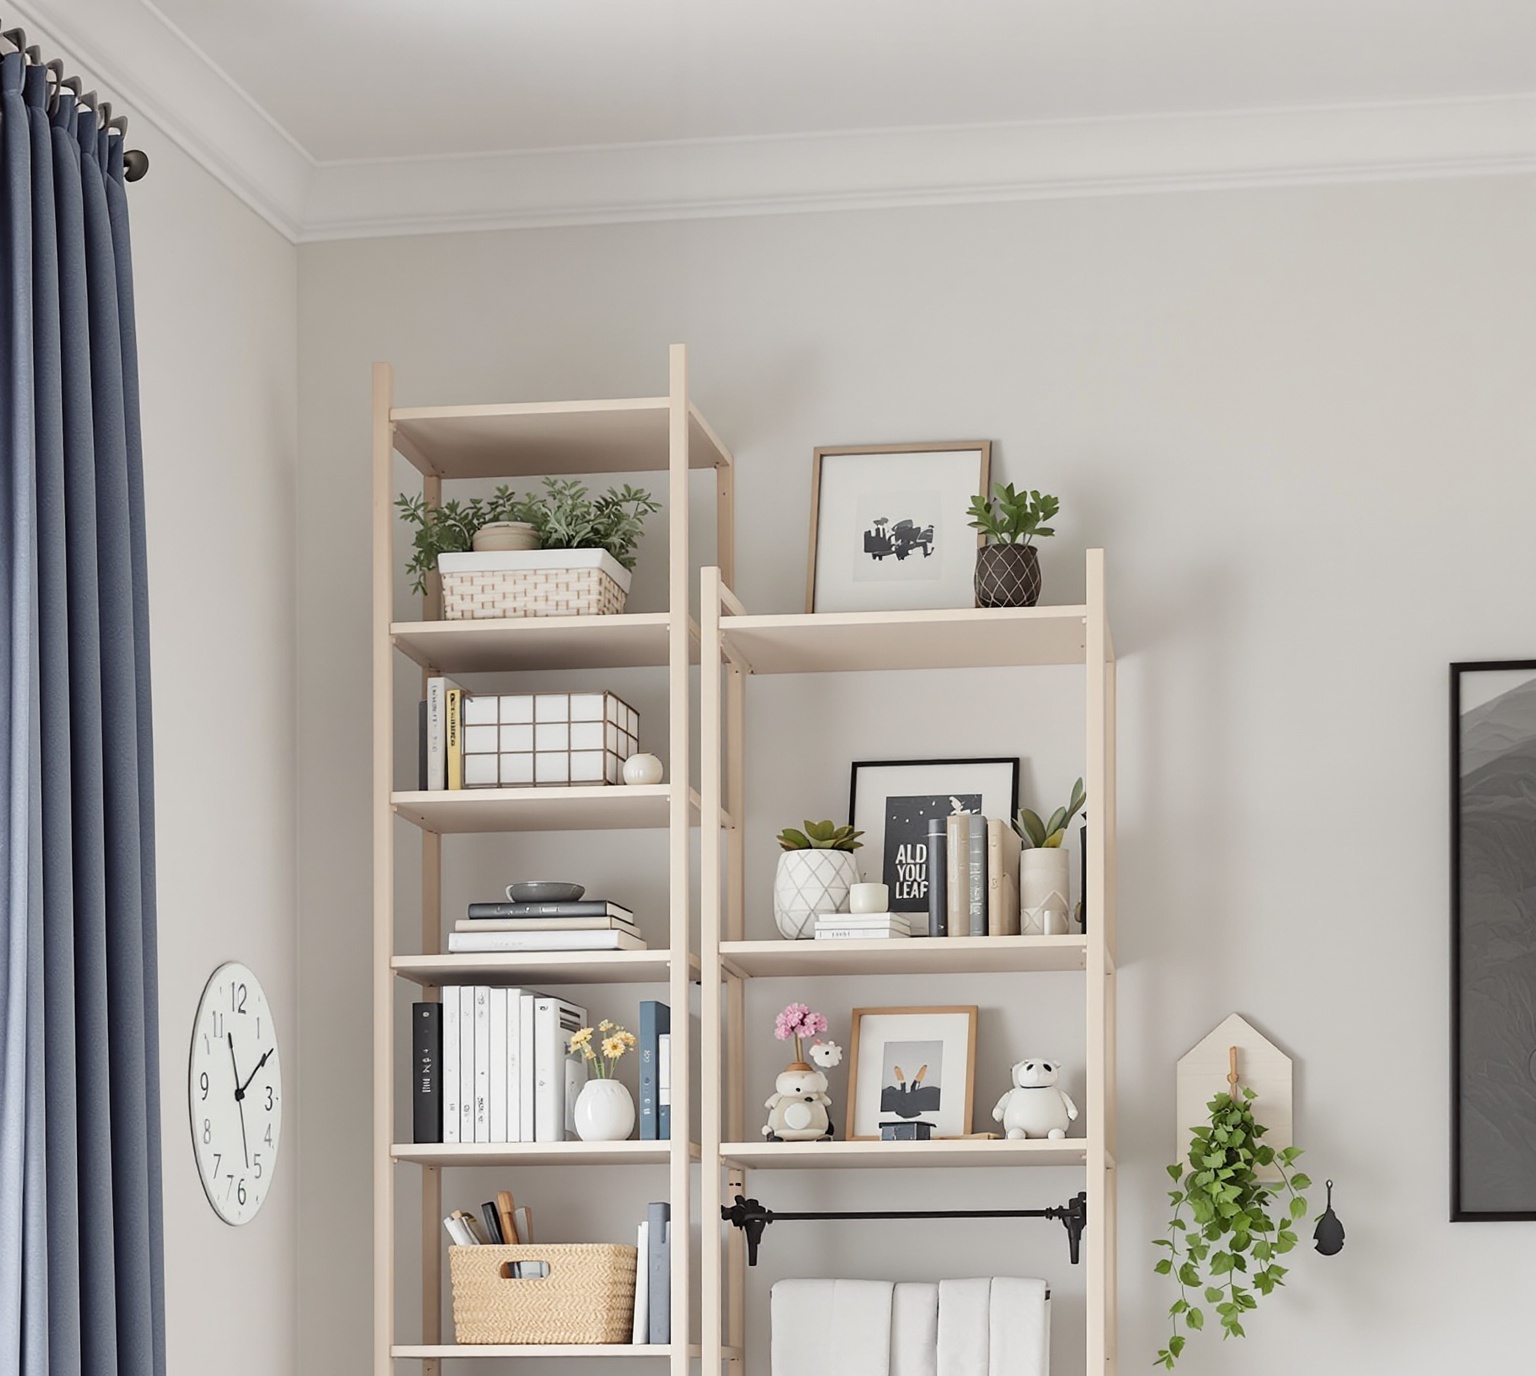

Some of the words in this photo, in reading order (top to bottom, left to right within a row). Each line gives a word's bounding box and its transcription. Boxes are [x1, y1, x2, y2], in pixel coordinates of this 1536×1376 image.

[895, 844, 927, 864] ALD
[897, 864, 926, 882] YOU
[896, 881, 929, 899] LEAF
[231, 981, 247, 1014] 12
[212, 1010, 224, 1038] 11
[200, 1072, 209, 1101] 9
[265, 1086, 273, 1111] 3
[203, 1118, 211, 1144] 8
[264, 1123, 272, 1147] 4
[213, 1153, 221, 1179] 7
[254, 1154, 262, 1179] 5
[237, 1178, 246, 1205] 6
